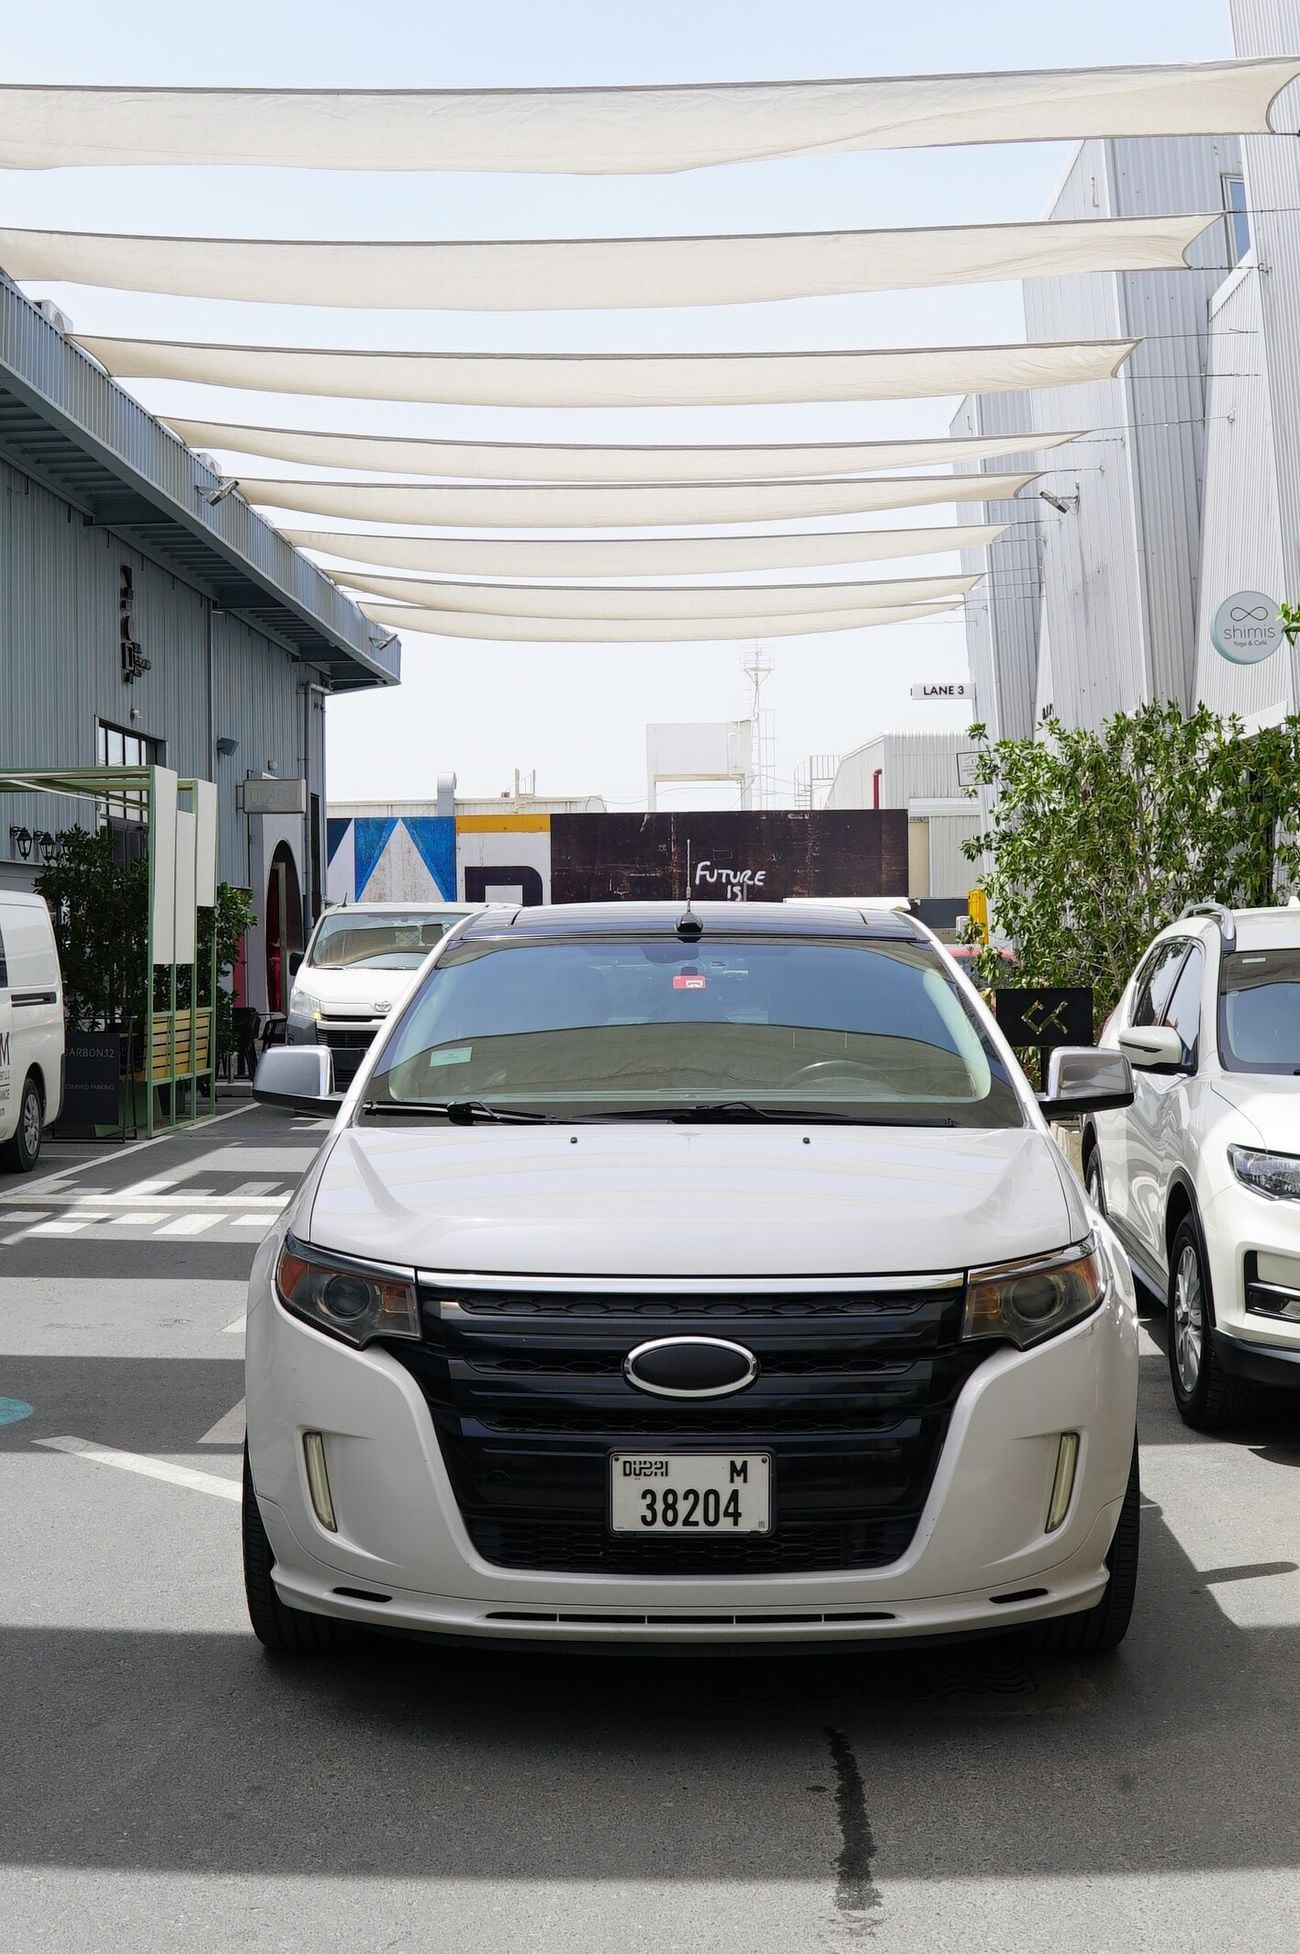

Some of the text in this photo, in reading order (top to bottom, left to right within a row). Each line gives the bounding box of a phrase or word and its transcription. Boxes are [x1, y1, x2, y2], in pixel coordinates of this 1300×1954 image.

[1223, 624, 1276, 640] shimis
[1233, 640, 1247, 648] Yoga
[923, 685, 965, 696] LANE 3
[695, 861, 766, 886] FUTURE
[623, 1460, 748, 1484] DUBAI M
[641, 1488, 742, 1527] 38204
